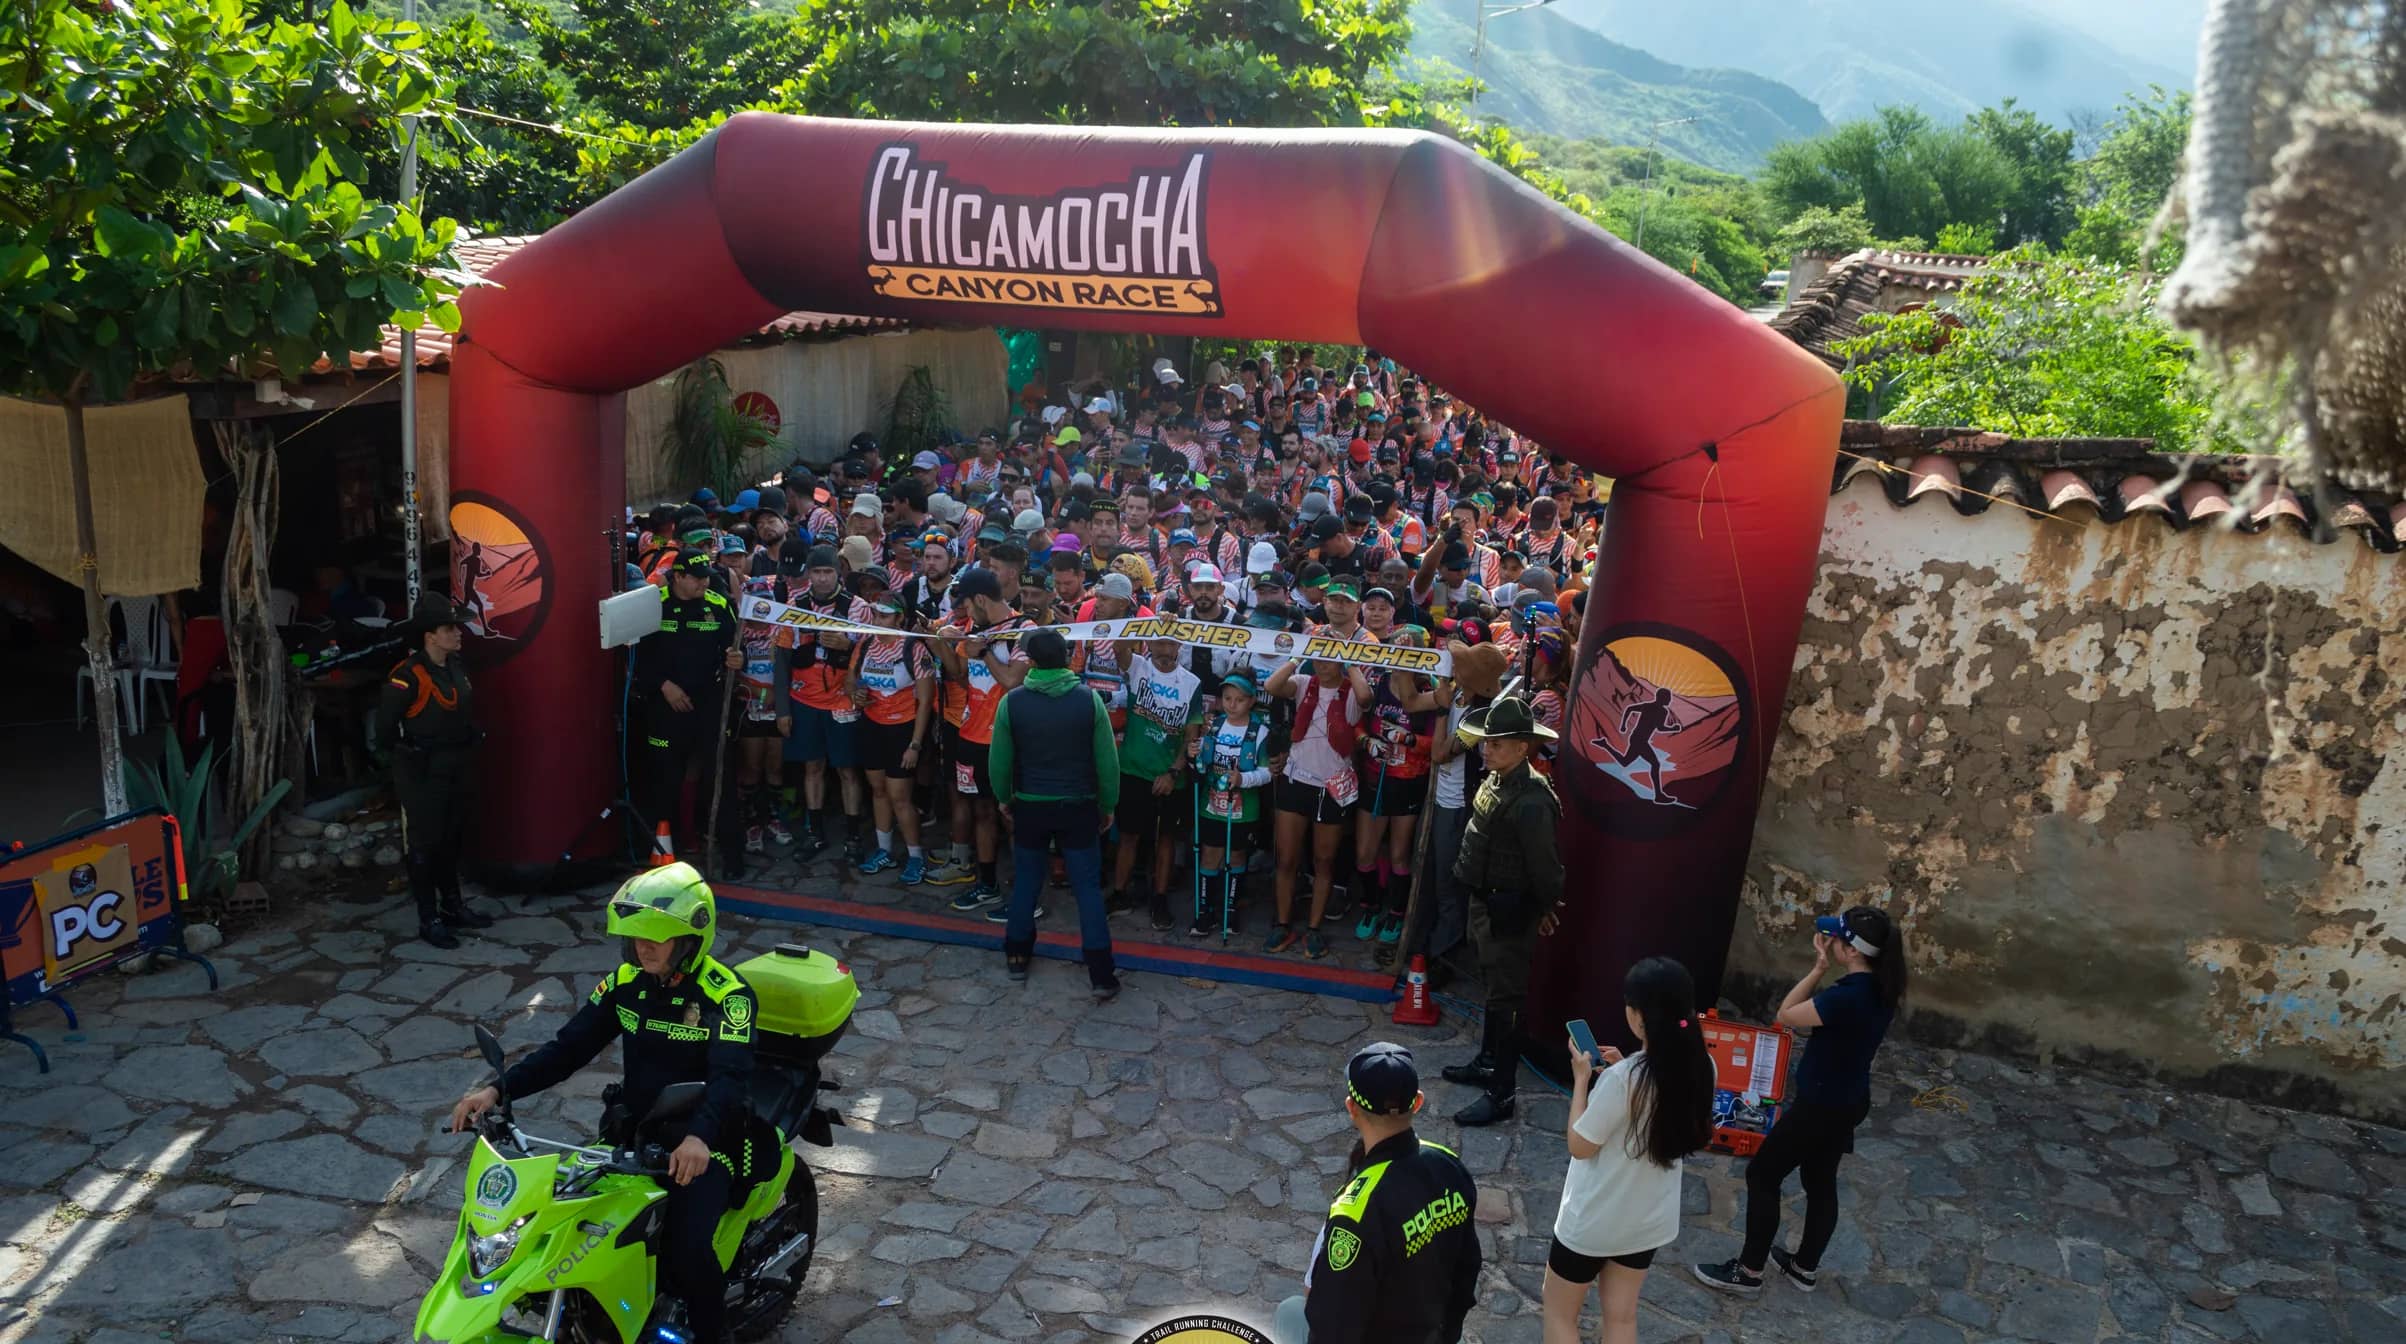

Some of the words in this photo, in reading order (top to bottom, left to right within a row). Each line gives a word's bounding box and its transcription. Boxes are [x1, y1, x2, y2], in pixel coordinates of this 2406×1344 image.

[869, 147, 1204, 275] CHICAMOCHA
[906, 273, 1063, 305] CANYON
[1073, 281, 1179, 309] RACE
[1119, 620, 1251, 648] FINISHER
[1303, 637, 1440, 671] FINISHER
[51, 890, 125, 959] PC
[1402, 1188, 1466, 1241] POLICÍA
[546, 1219, 617, 1285] POLICA
